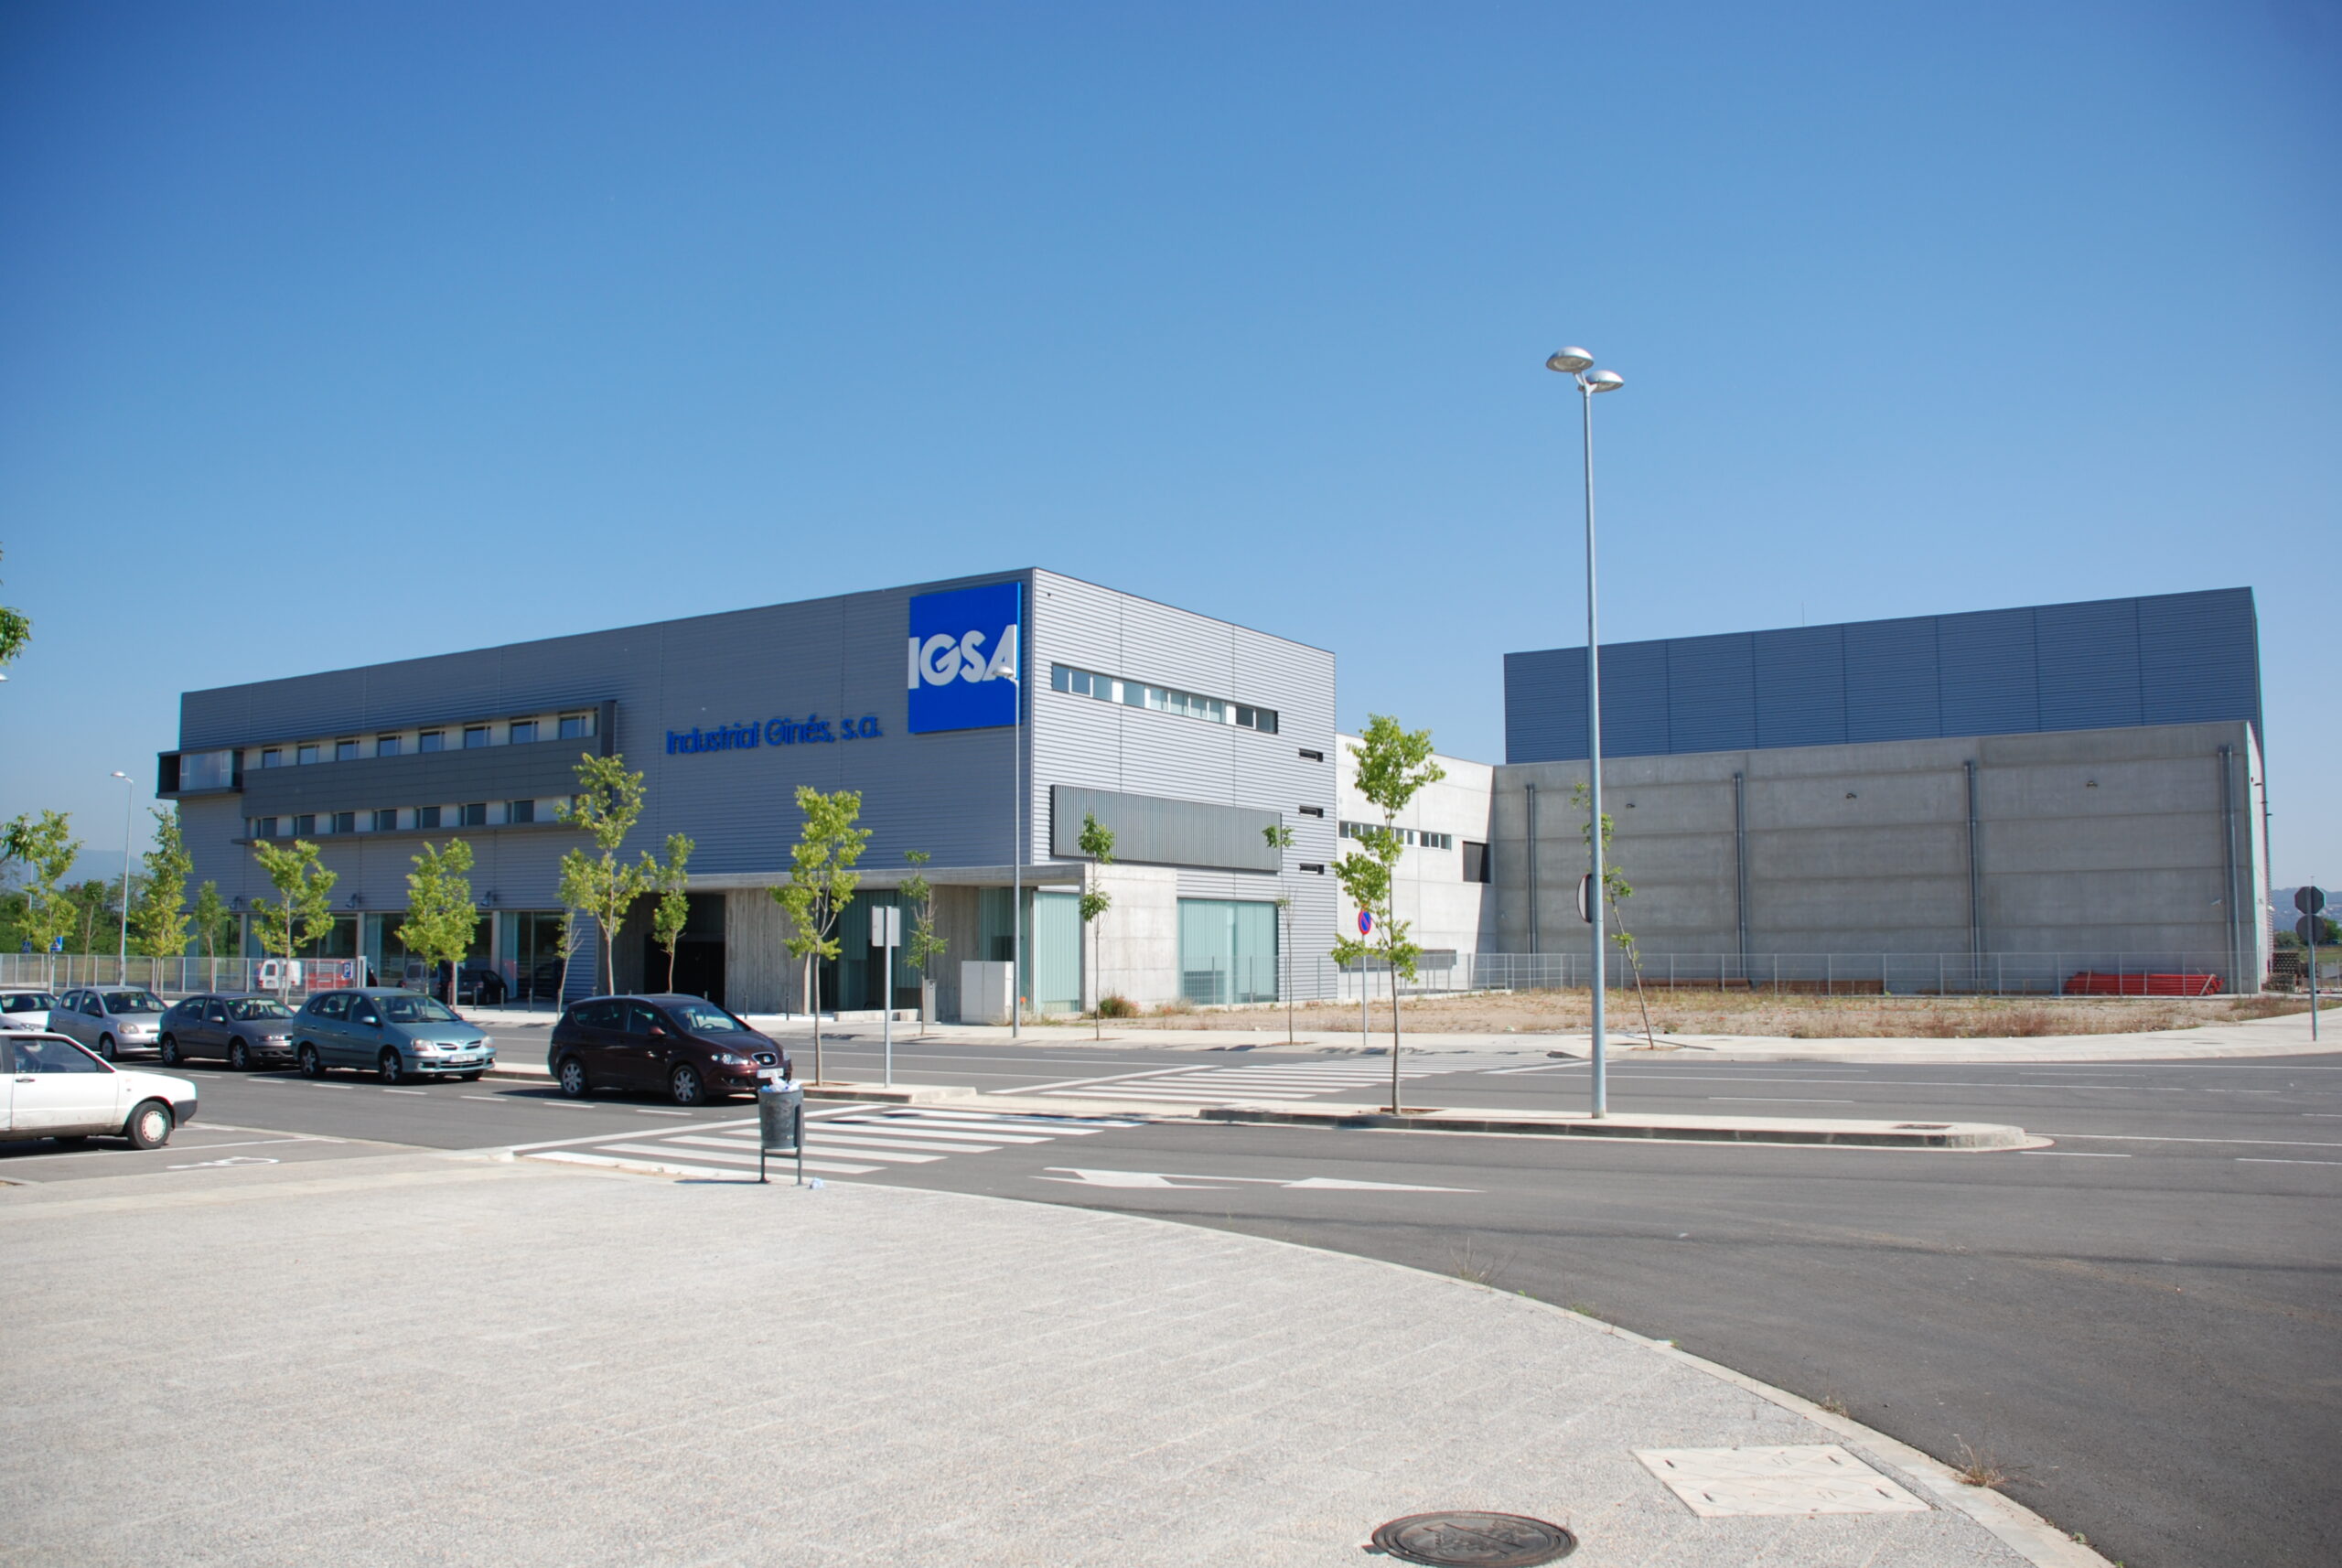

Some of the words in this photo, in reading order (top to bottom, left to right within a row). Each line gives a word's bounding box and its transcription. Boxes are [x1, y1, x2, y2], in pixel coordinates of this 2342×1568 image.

[908, 624, 1017, 689] IGSA
[666, 721, 760, 755] Industrial
[764, 714, 835, 746] Ginés,
[841, 714, 883, 740] s.a.
